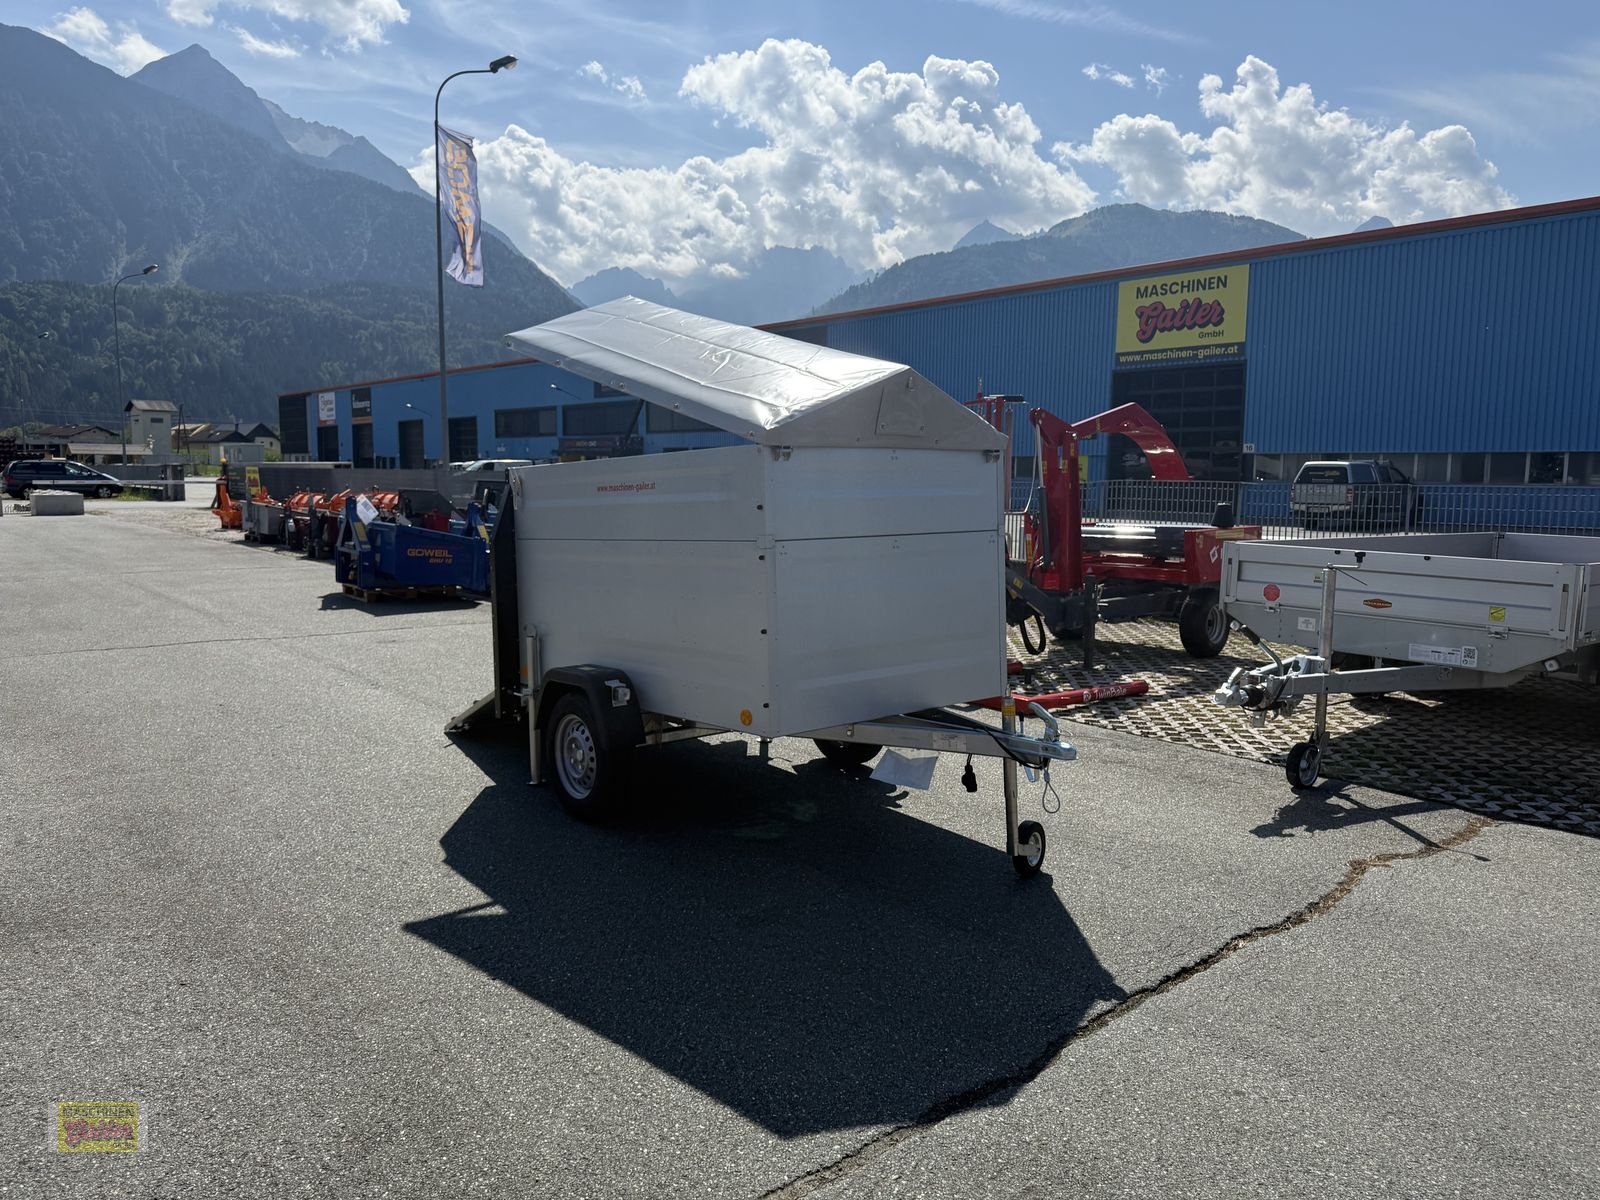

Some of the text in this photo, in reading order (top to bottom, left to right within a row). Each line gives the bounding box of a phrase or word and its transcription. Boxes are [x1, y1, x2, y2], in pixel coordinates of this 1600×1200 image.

[1136, 274, 1228, 299] MASCHINEN
[1135, 297, 1225, 344] Gailer
[1198, 329, 1224, 339] GmbH
[1119, 345, 1238, 363] www.maschinen-gailer.at
[1093, 686, 1127, 700] TwinBale
